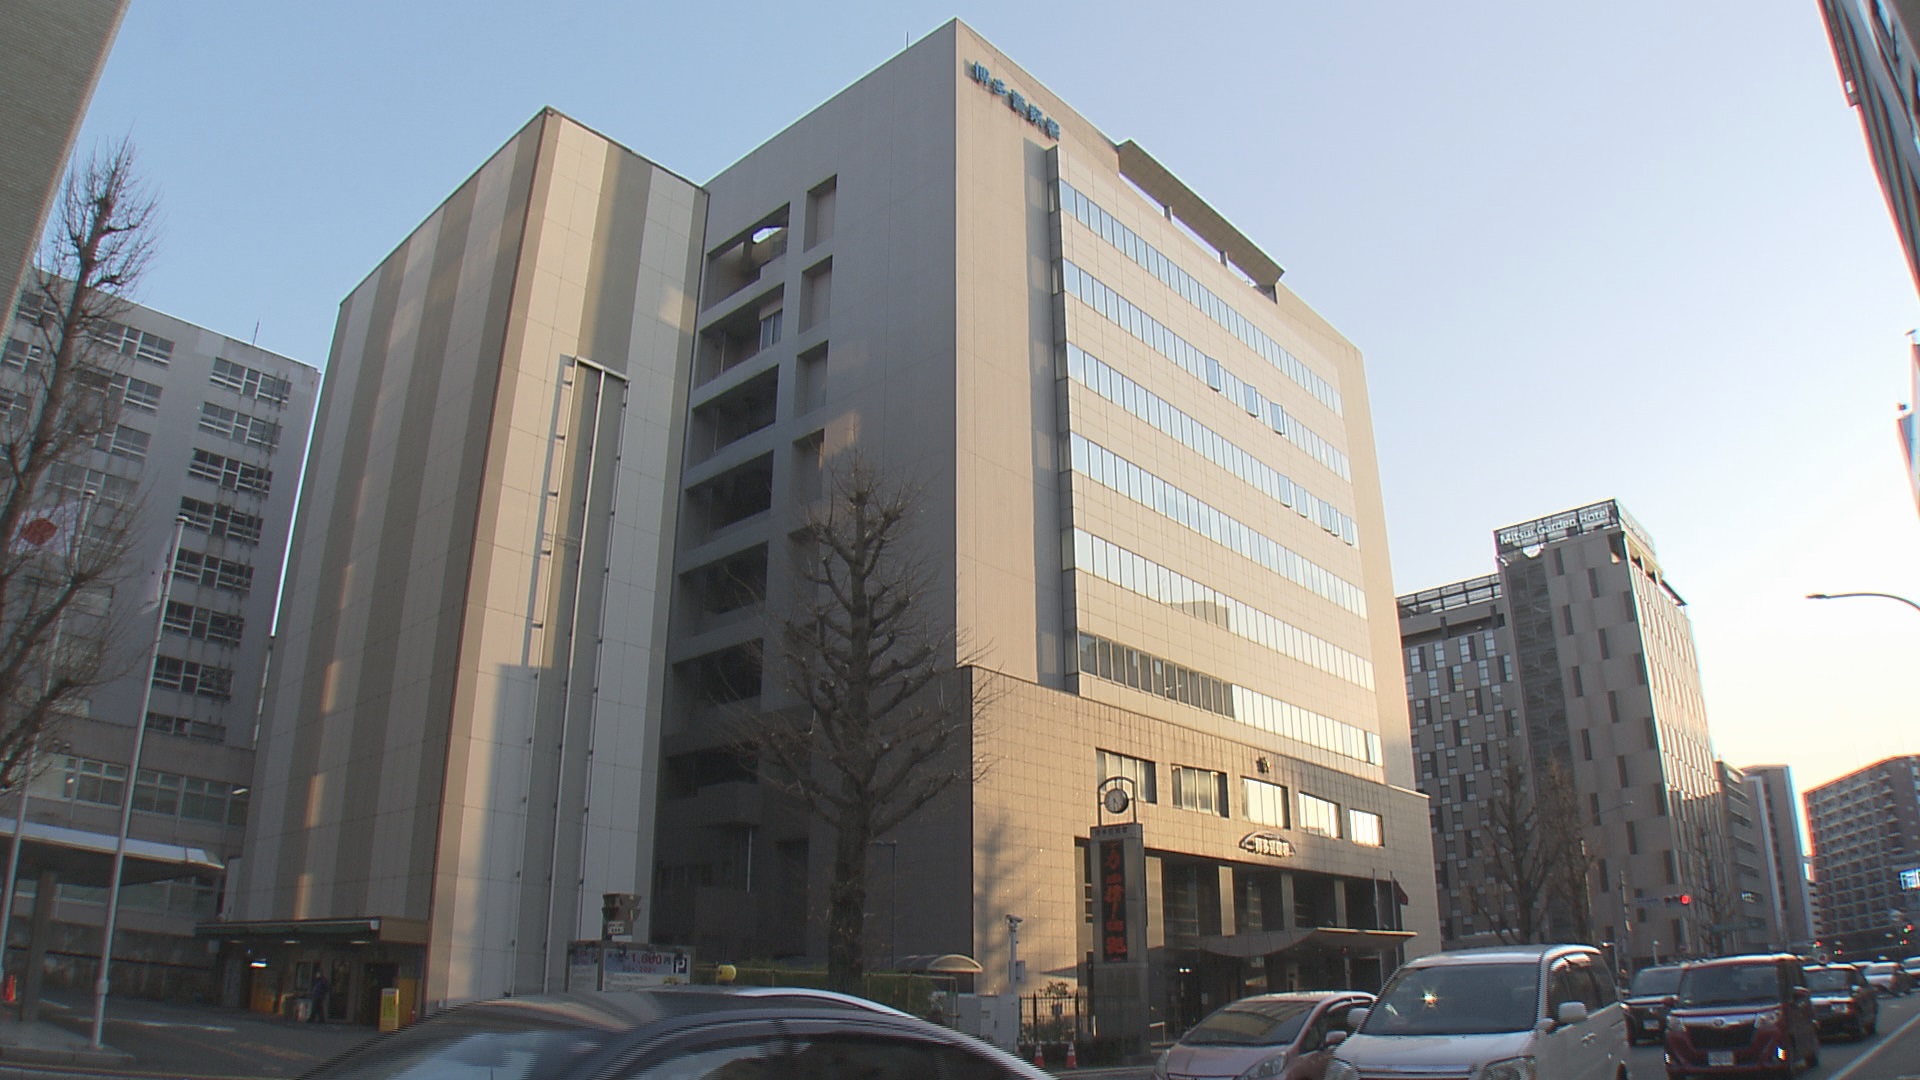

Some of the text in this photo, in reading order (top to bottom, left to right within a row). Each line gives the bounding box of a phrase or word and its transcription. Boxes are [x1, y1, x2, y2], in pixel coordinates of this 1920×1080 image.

[1500, 506, 1609, 545] Mitsui Garden Hotel
